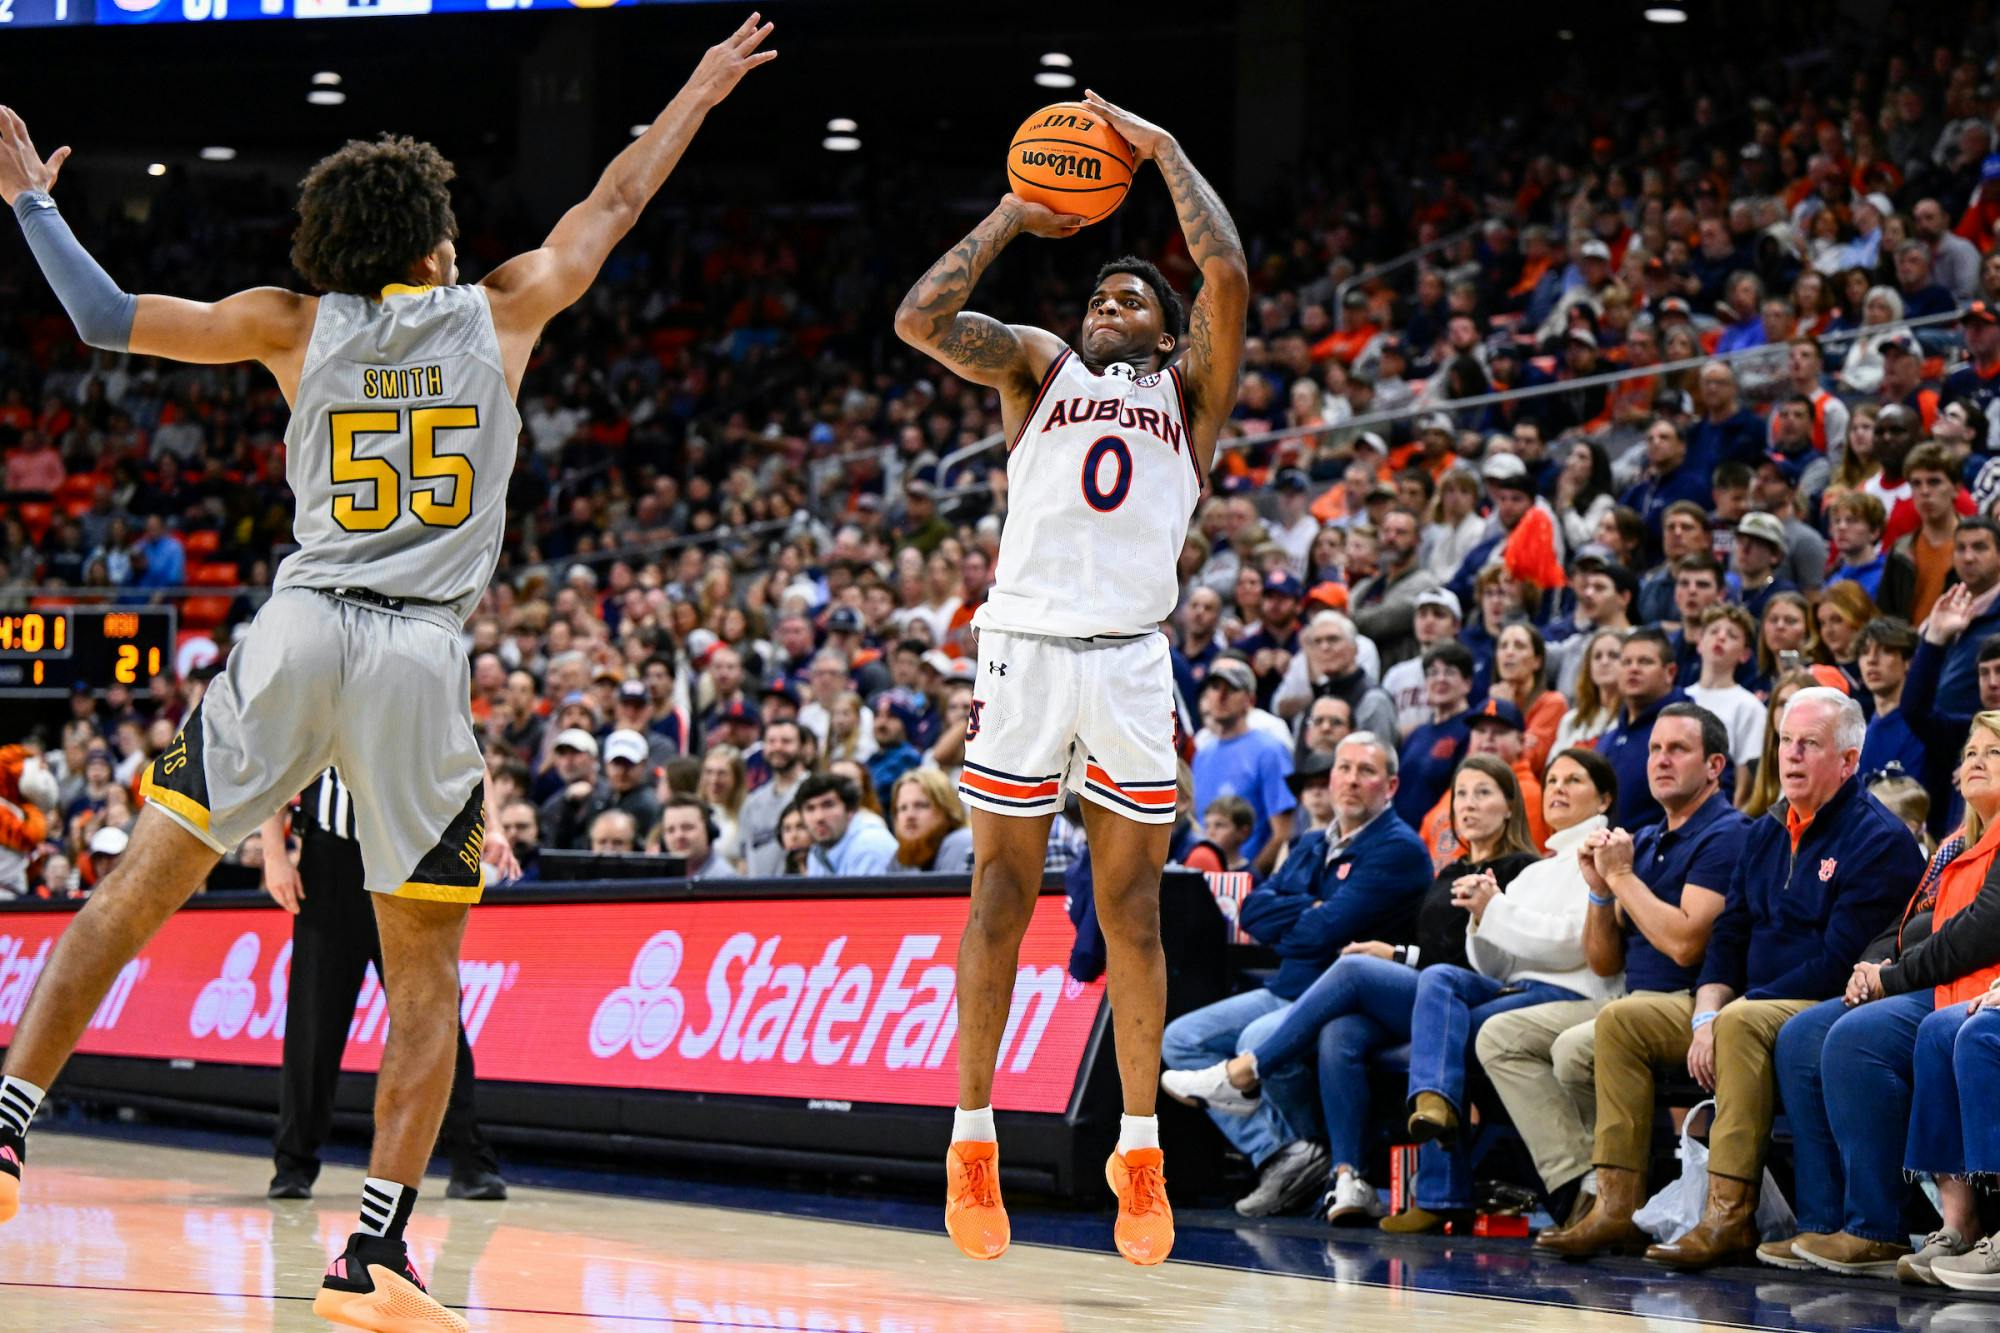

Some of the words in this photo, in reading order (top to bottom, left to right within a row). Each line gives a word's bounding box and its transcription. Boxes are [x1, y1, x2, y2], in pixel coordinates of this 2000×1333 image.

[1043, 114, 1094, 132] EVO
[1022, 150, 1102, 180] Wilson
[364, 366, 443, 398] SMITH
[1138, 373, 1160, 387] SEC
[1041, 397, 1182, 455] AUBURN
[328, 405, 480, 532] 55
[1081, 435, 1133, 512] 0
[33, 659, 44, 685] 1
[115, 644, 161, 684] 21
[677, 932, 874, 1066] State
